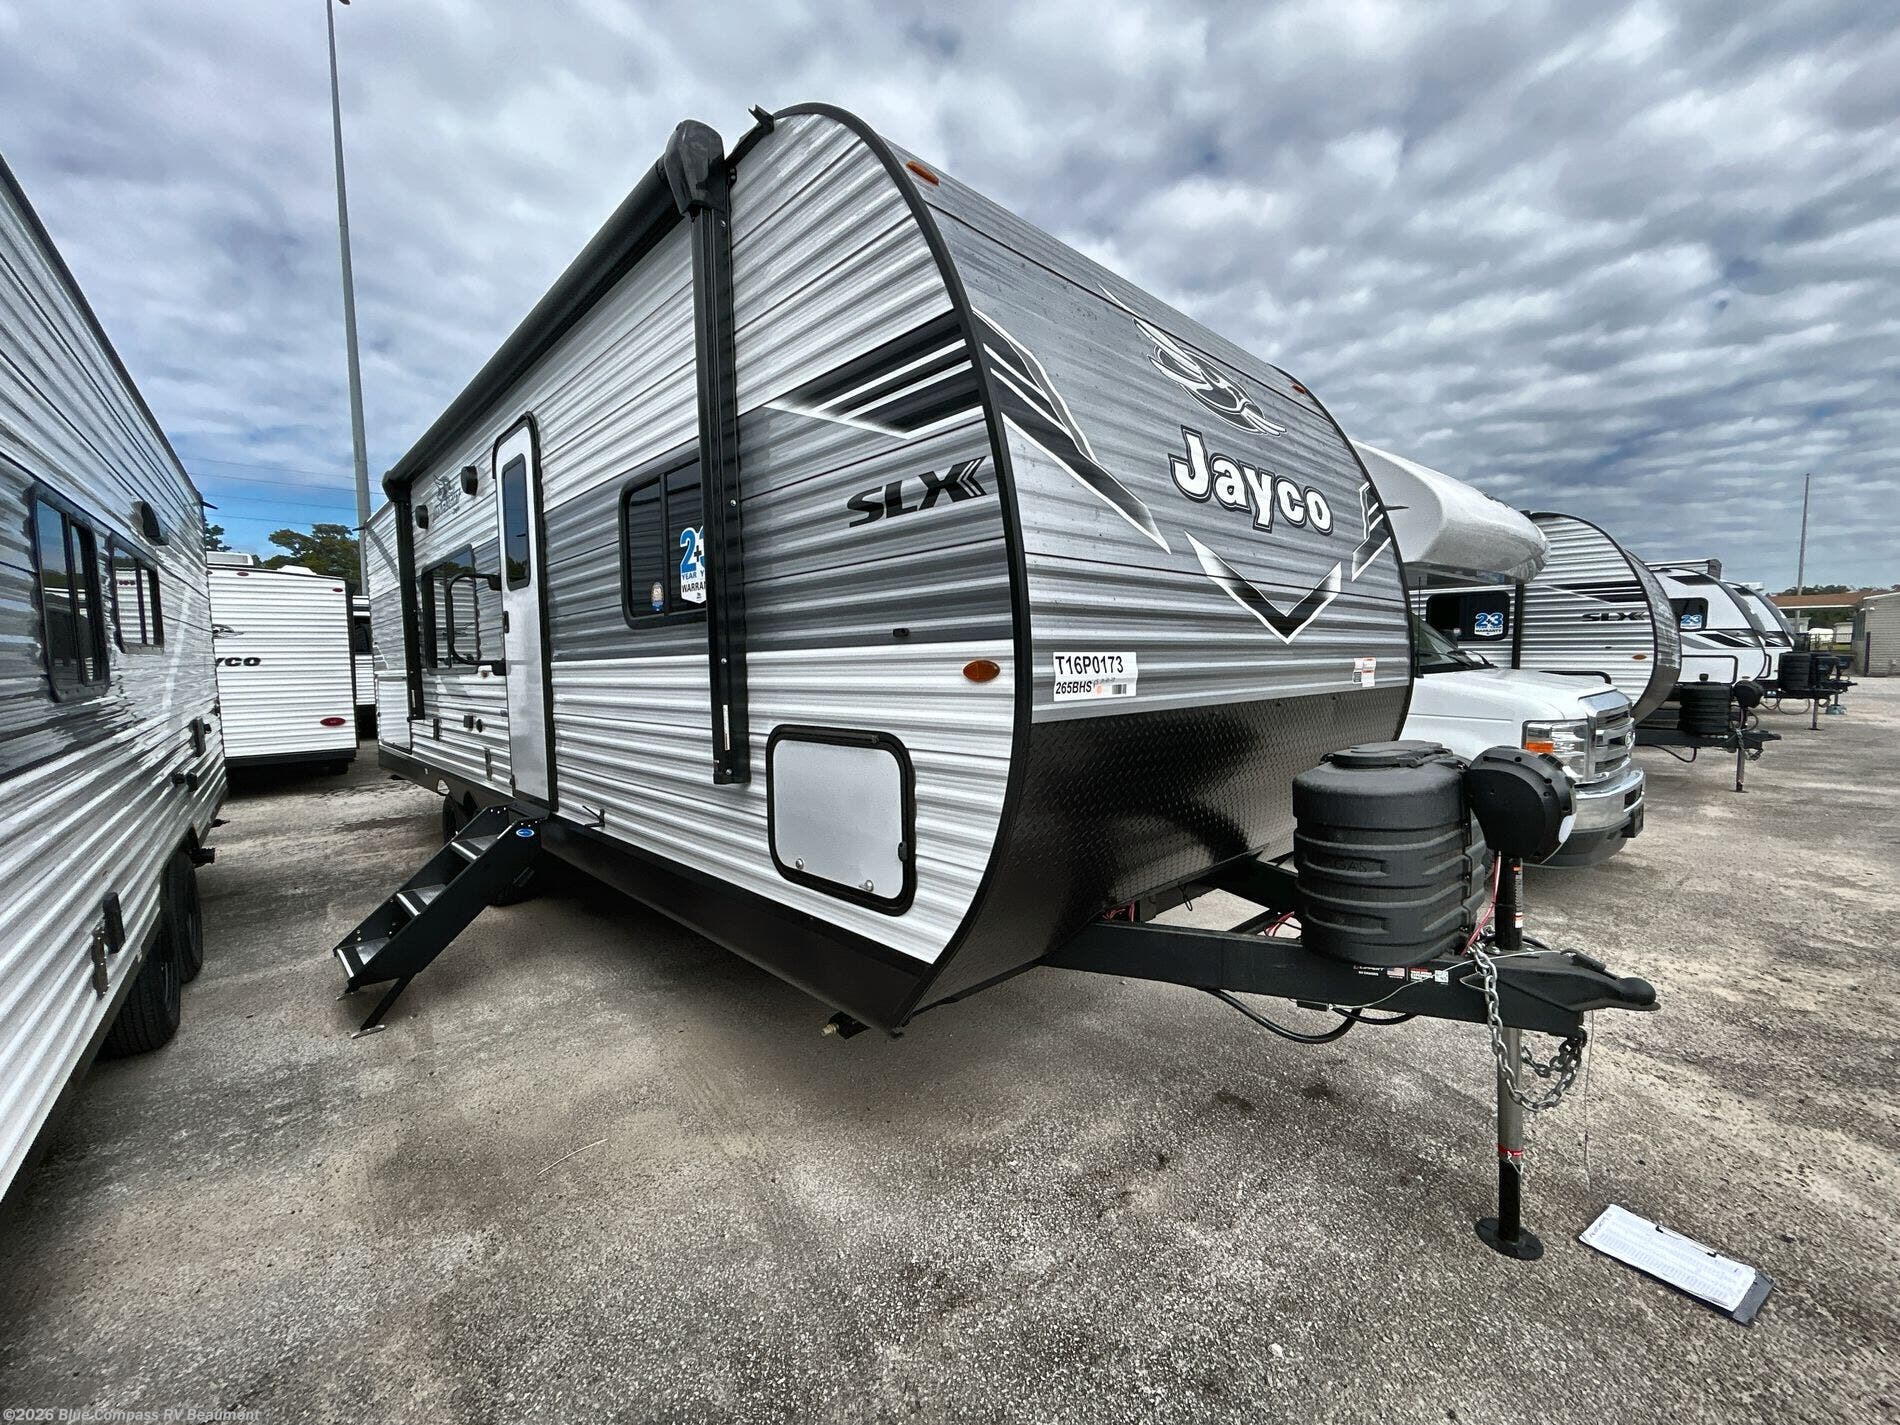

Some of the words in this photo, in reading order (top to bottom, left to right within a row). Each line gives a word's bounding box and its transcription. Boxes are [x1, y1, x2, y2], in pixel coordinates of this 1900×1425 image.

[1168, 425, 1333, 536] Jayco
[847, 456, 987, 528] SLX
[681, 572, 697, 580] YEAR
[1582, 612, 1646, 621] SLX
[1055, 655, 1124, 675] T16P0173
[1055, 680, 1093, 695] 265BHS
